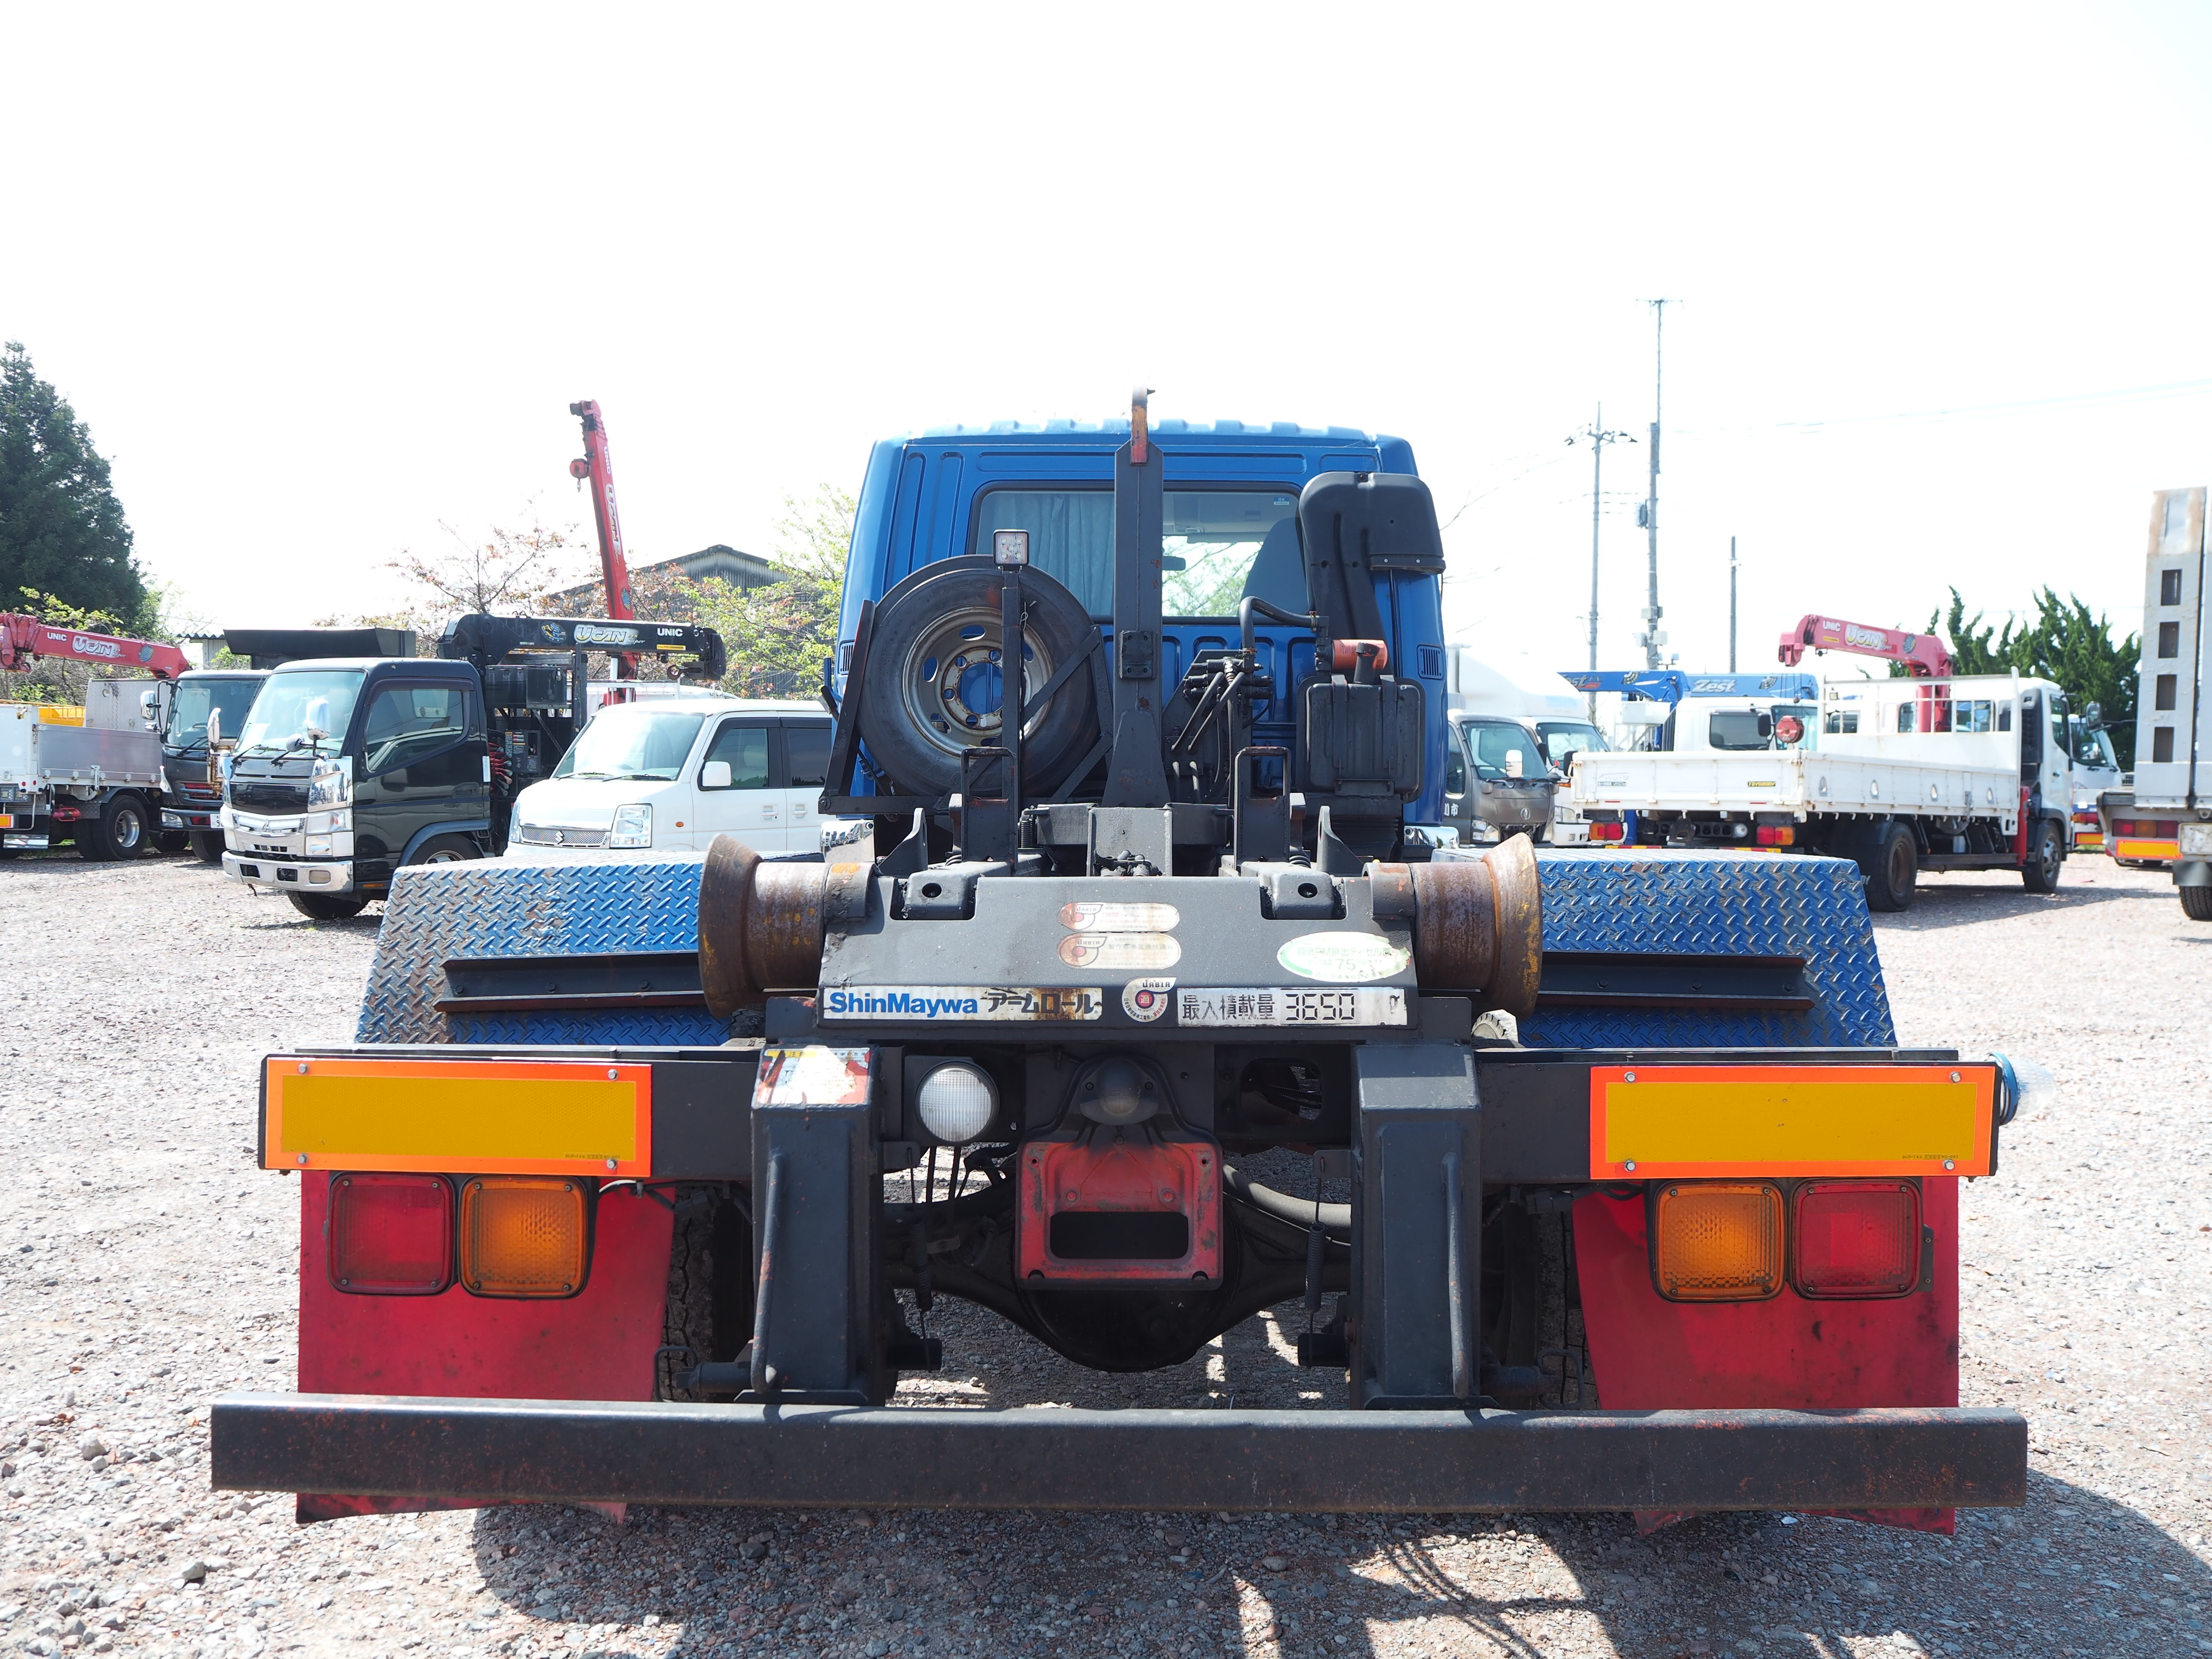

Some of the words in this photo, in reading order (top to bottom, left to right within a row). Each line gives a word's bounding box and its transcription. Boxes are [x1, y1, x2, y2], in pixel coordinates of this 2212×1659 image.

[657, 627, 684, 637] UNIC
[1823, 620, 1841, 632] UNIC
[47, 632, 67, 642] UNIC
[1692, 679, 1736, 694] Zest
[829, 992, 978, 1018] ShinMaywa
[986, 992, 1095, 1013] アームロール
[1285, 993, 1355, 1021] 3650
